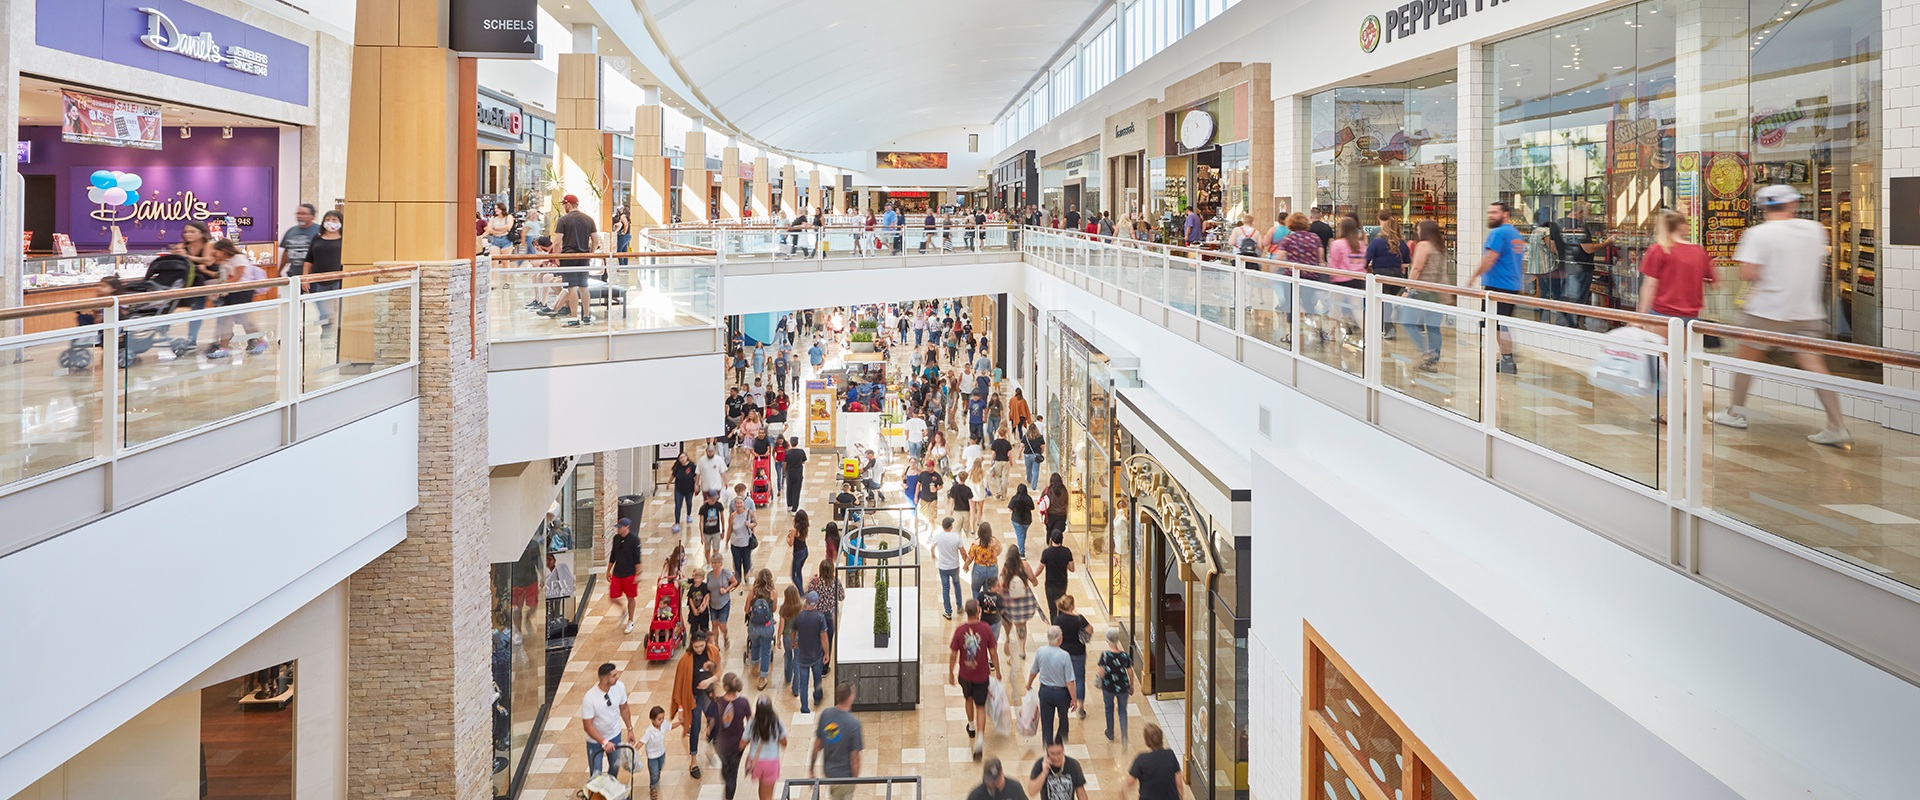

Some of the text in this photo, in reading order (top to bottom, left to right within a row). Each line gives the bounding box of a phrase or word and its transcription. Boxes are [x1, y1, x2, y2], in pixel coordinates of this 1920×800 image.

[483, 19, 534, 30] SCHEELS
[1385, 0, 1468, 43] PEPPER
[138, 7, 222, 63] Daniel's
[233, 46, 268, 64] JEWELERS
[233, 60, 268, 77] SINCE 1948
[477, 101, 511, 130] Buckle
[1707, 198, 1749, 212] BUY 10
[1707, 216, 1746, 230] 3 MORE
